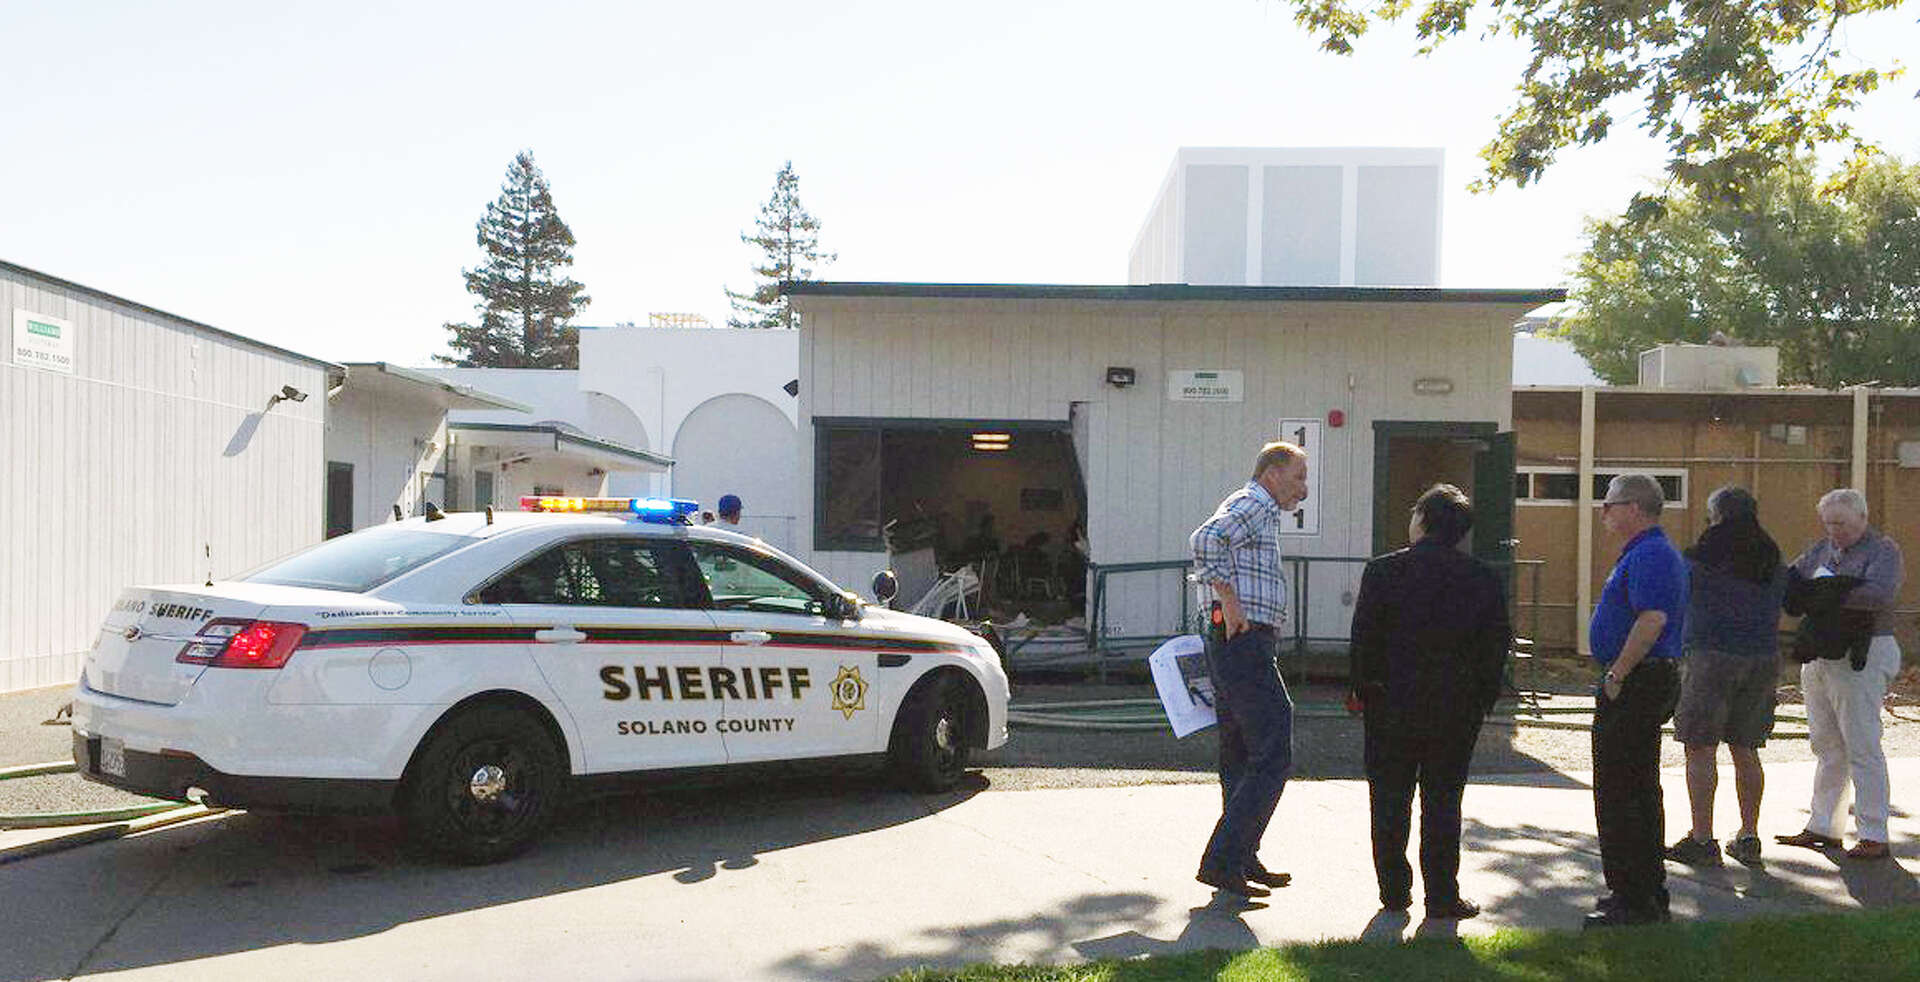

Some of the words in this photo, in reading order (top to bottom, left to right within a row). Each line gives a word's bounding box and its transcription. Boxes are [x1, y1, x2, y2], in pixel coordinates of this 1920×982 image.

[1294, 426, 1306, 447] 1
[1292, 508, 1305, 529] 1
[149, 603, 213, 622] SHERIFF
[599, 665, 811, 701] SHERIFF
[617, 720, 707, 735] SOLANO
[715, 718, 795, 733] COUNTY
